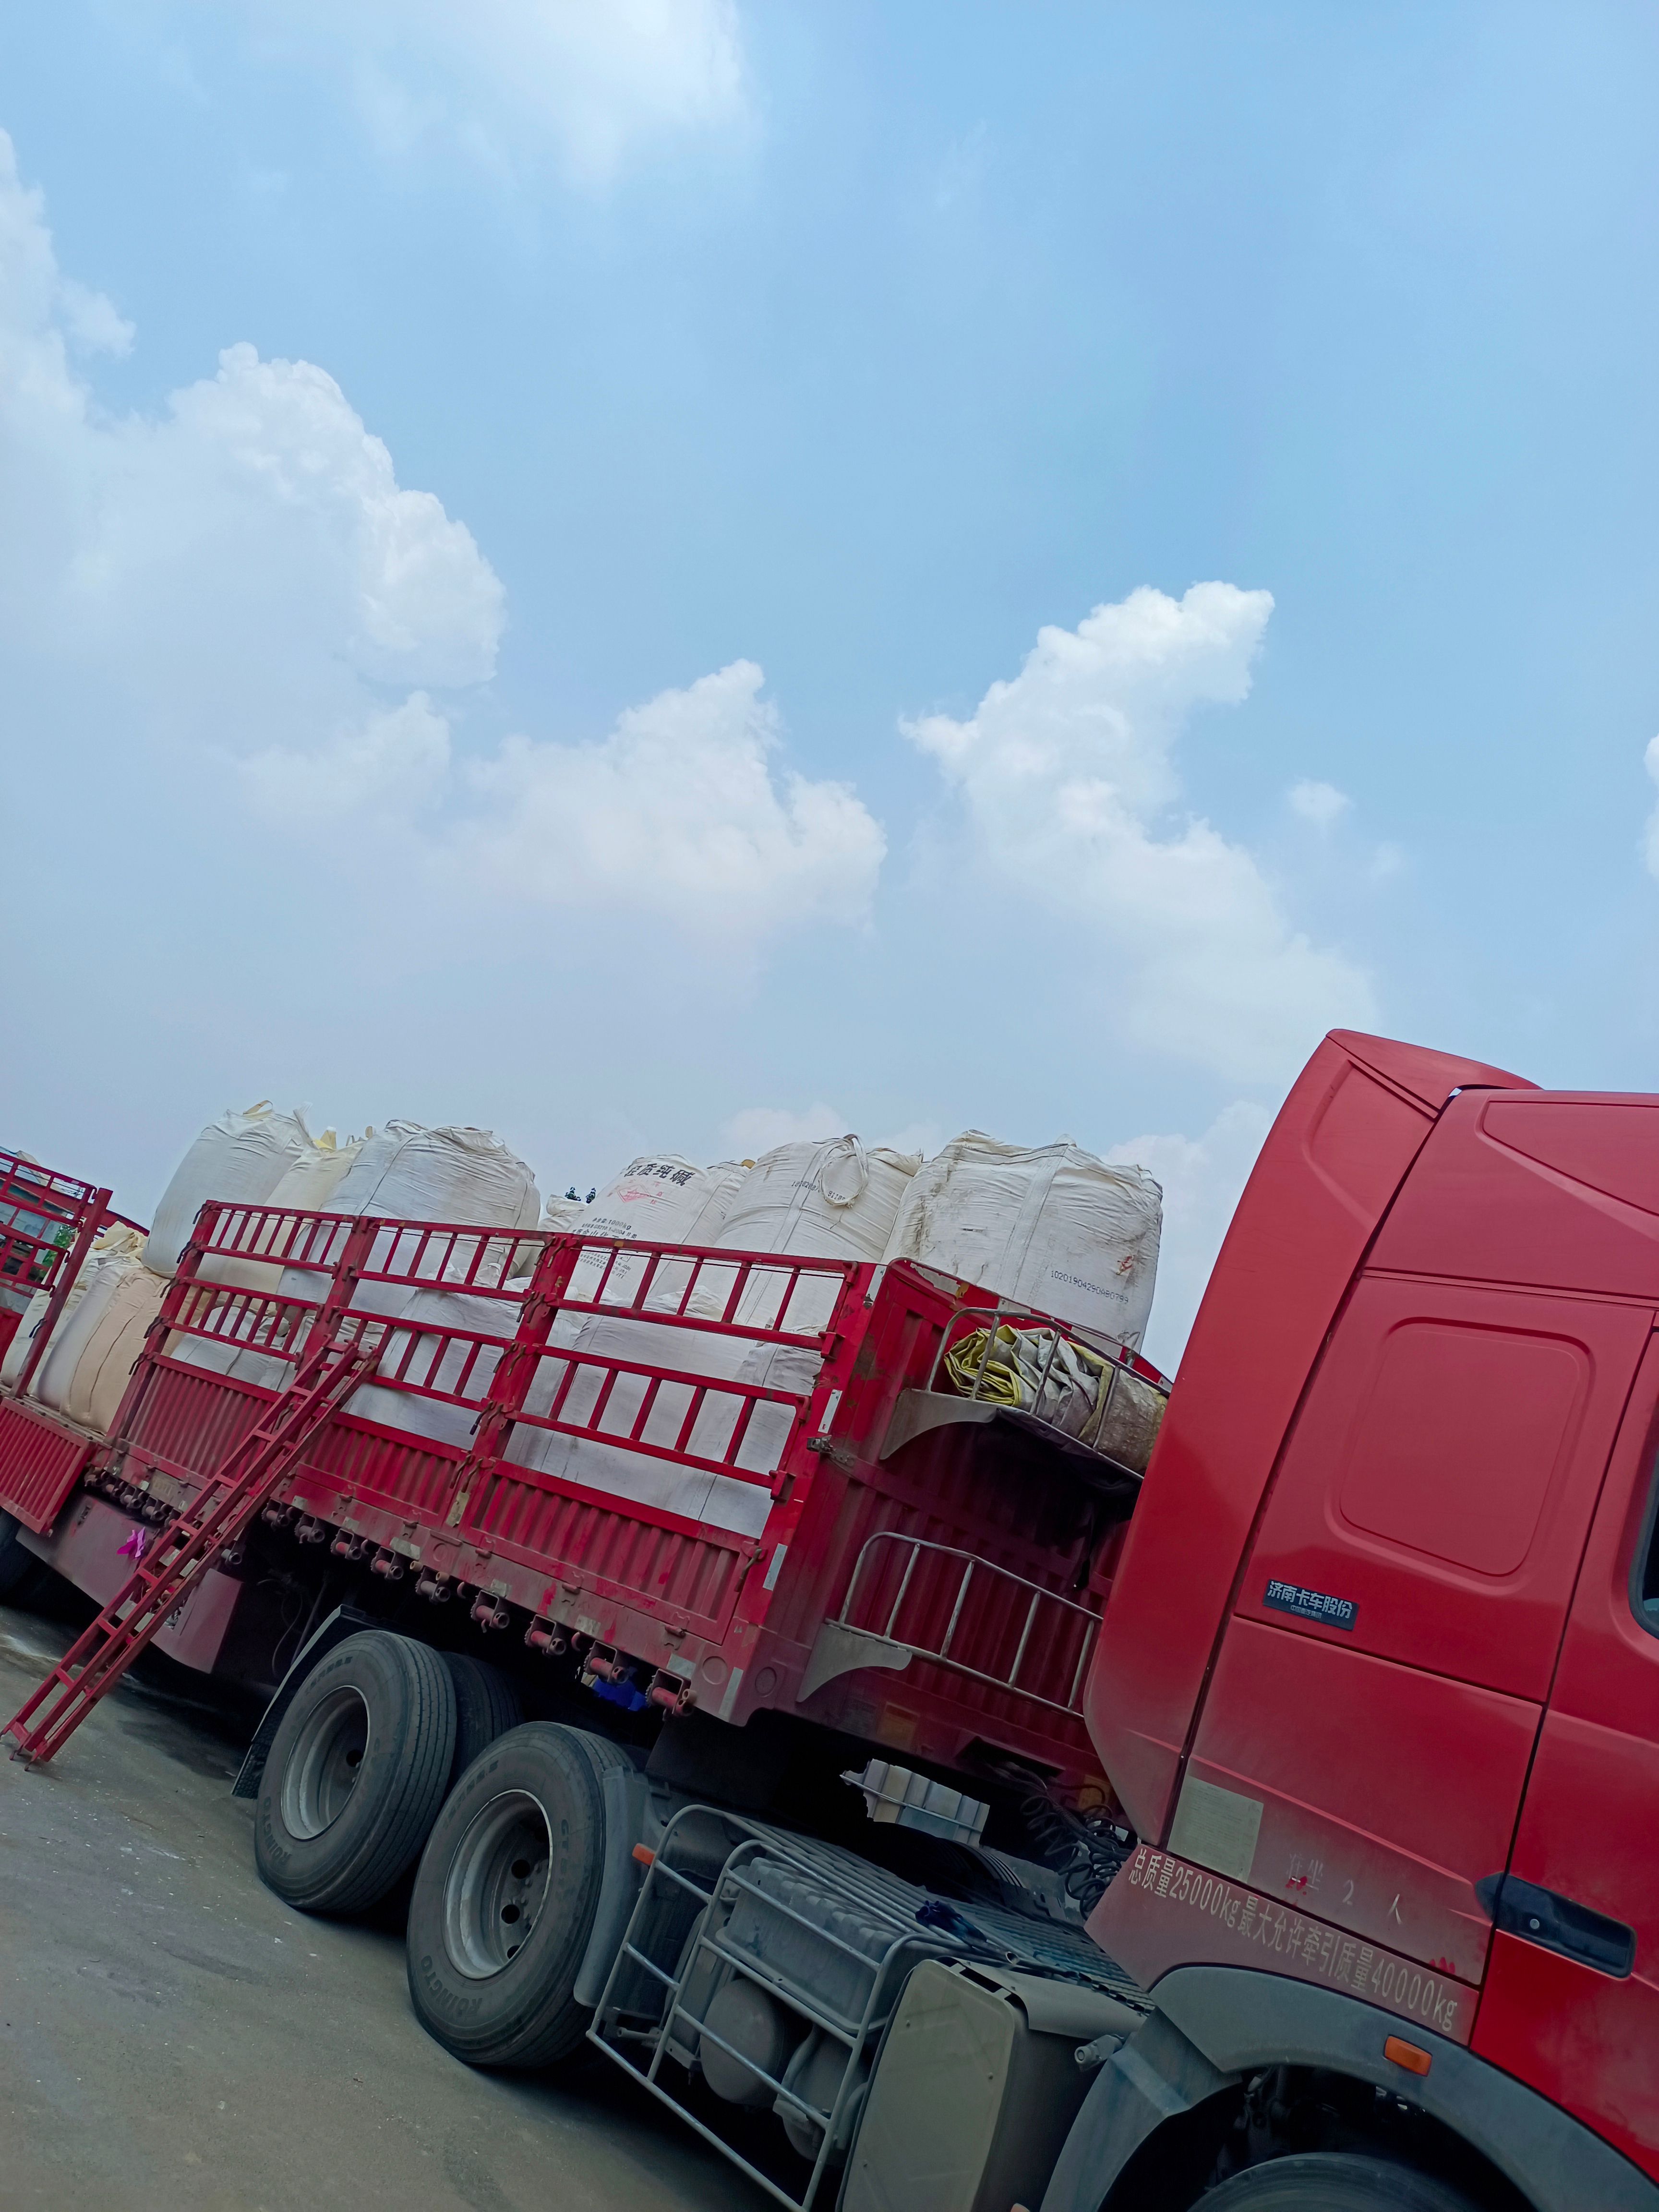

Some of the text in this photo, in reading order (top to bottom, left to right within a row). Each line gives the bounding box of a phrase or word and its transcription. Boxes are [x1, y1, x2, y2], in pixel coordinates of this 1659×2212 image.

[1267, 1580, 1353, 1619] 济南卡车股份
